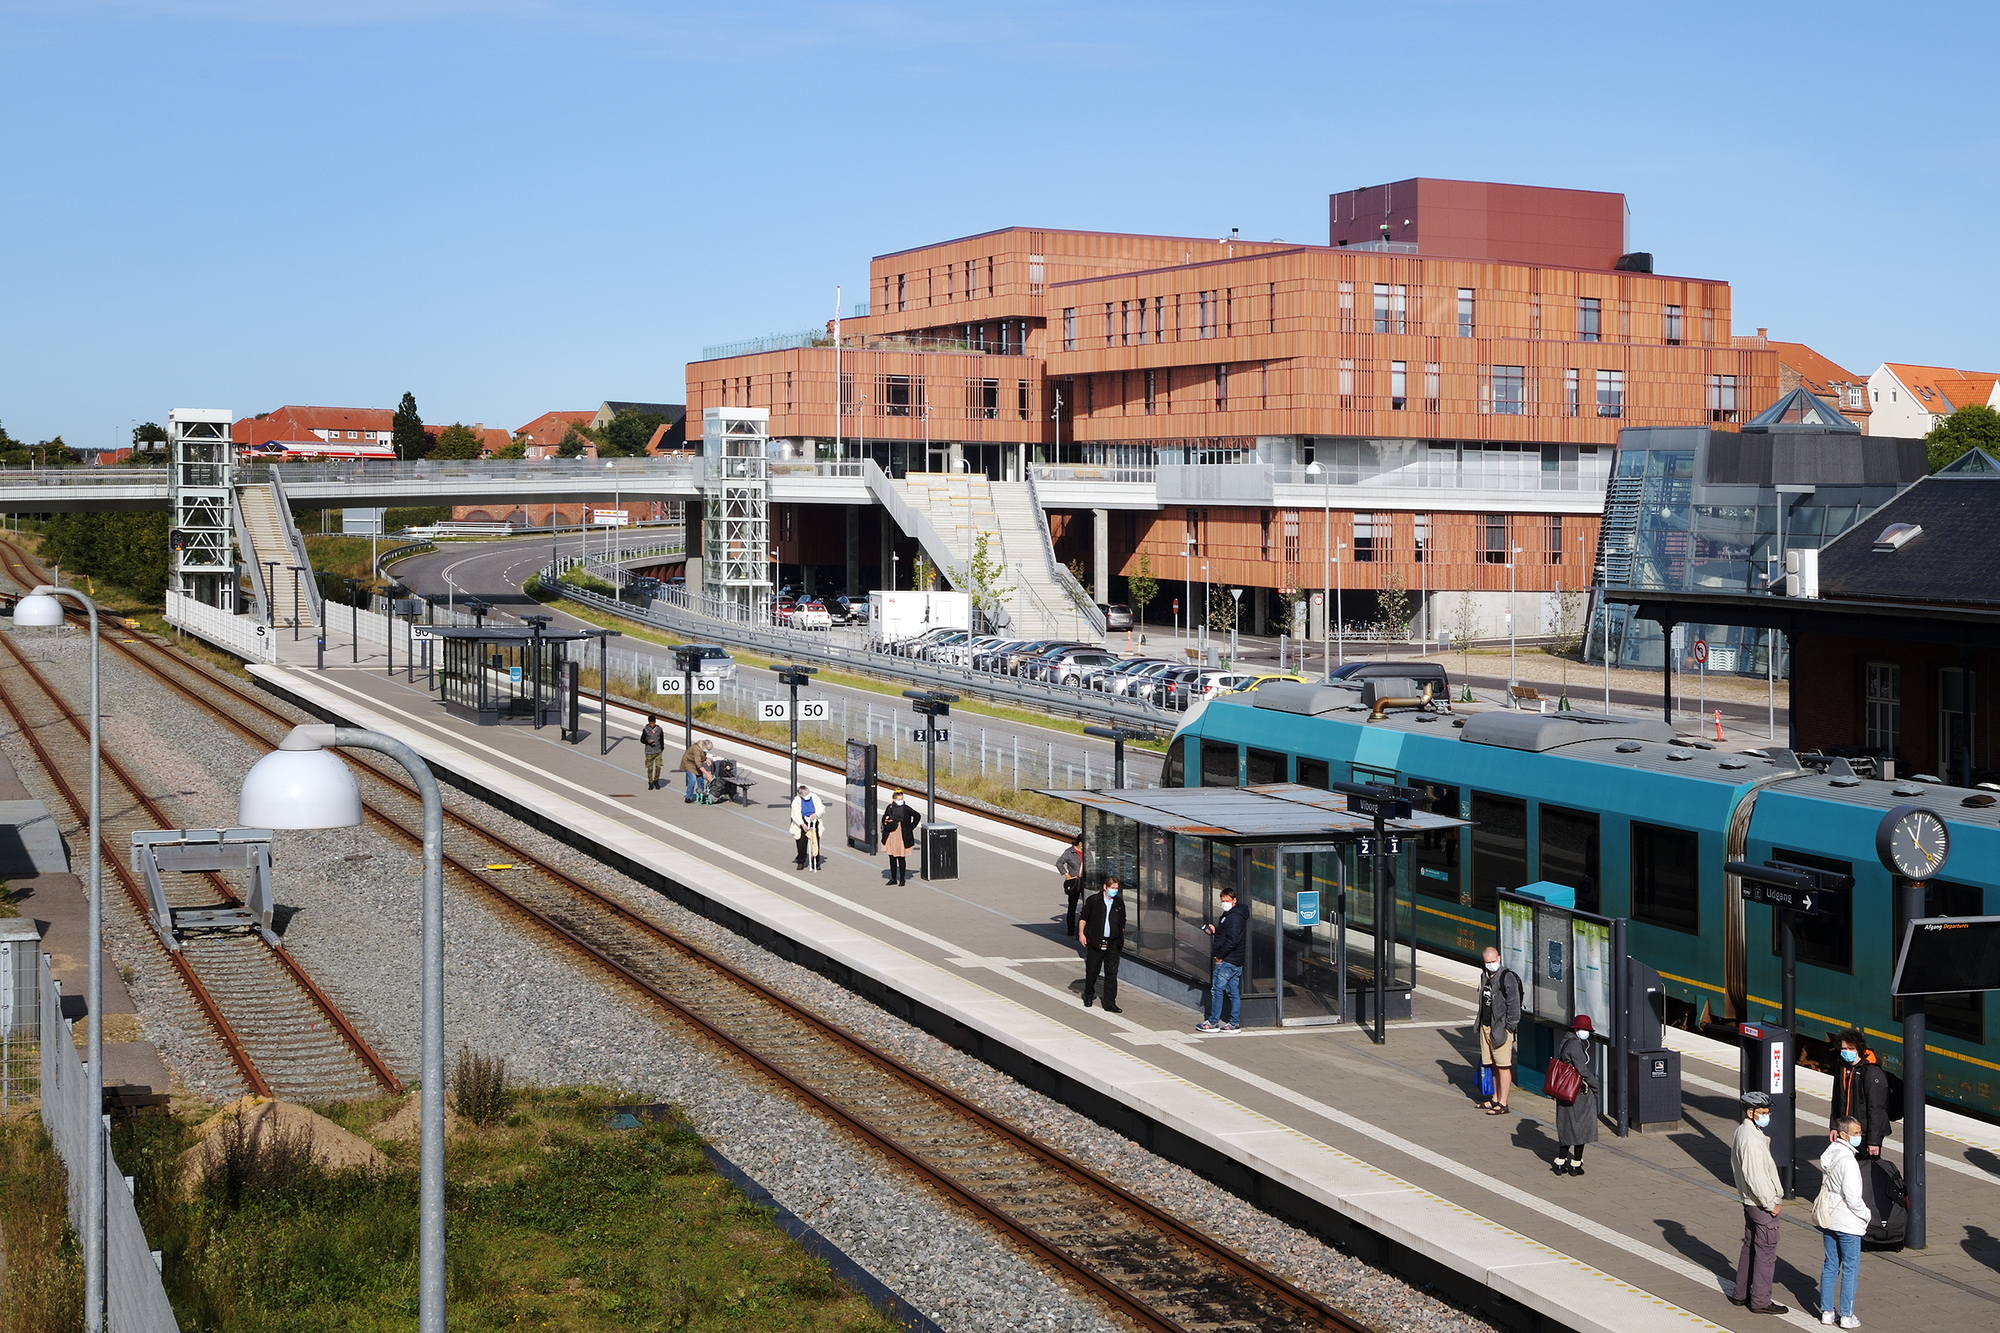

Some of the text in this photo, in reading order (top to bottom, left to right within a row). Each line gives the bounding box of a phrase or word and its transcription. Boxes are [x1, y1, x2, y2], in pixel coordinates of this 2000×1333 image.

[256, 626, 265, 636] S
[415, 629, 428, 637] 90
[662, 680, 680, 691] 60
[698, 680, 715, 691] 60
[764, 705, 784, 717] 50
[804, 705, 823, 716] 50
[917, 733, 923, 741] 2
[1359, 799, 1379, 814] Viborg
[1361, 843, 1369, 854] 2
[1391, 843, 1398, 853] 1
[1766, 888, 1792, 904] Udgang
